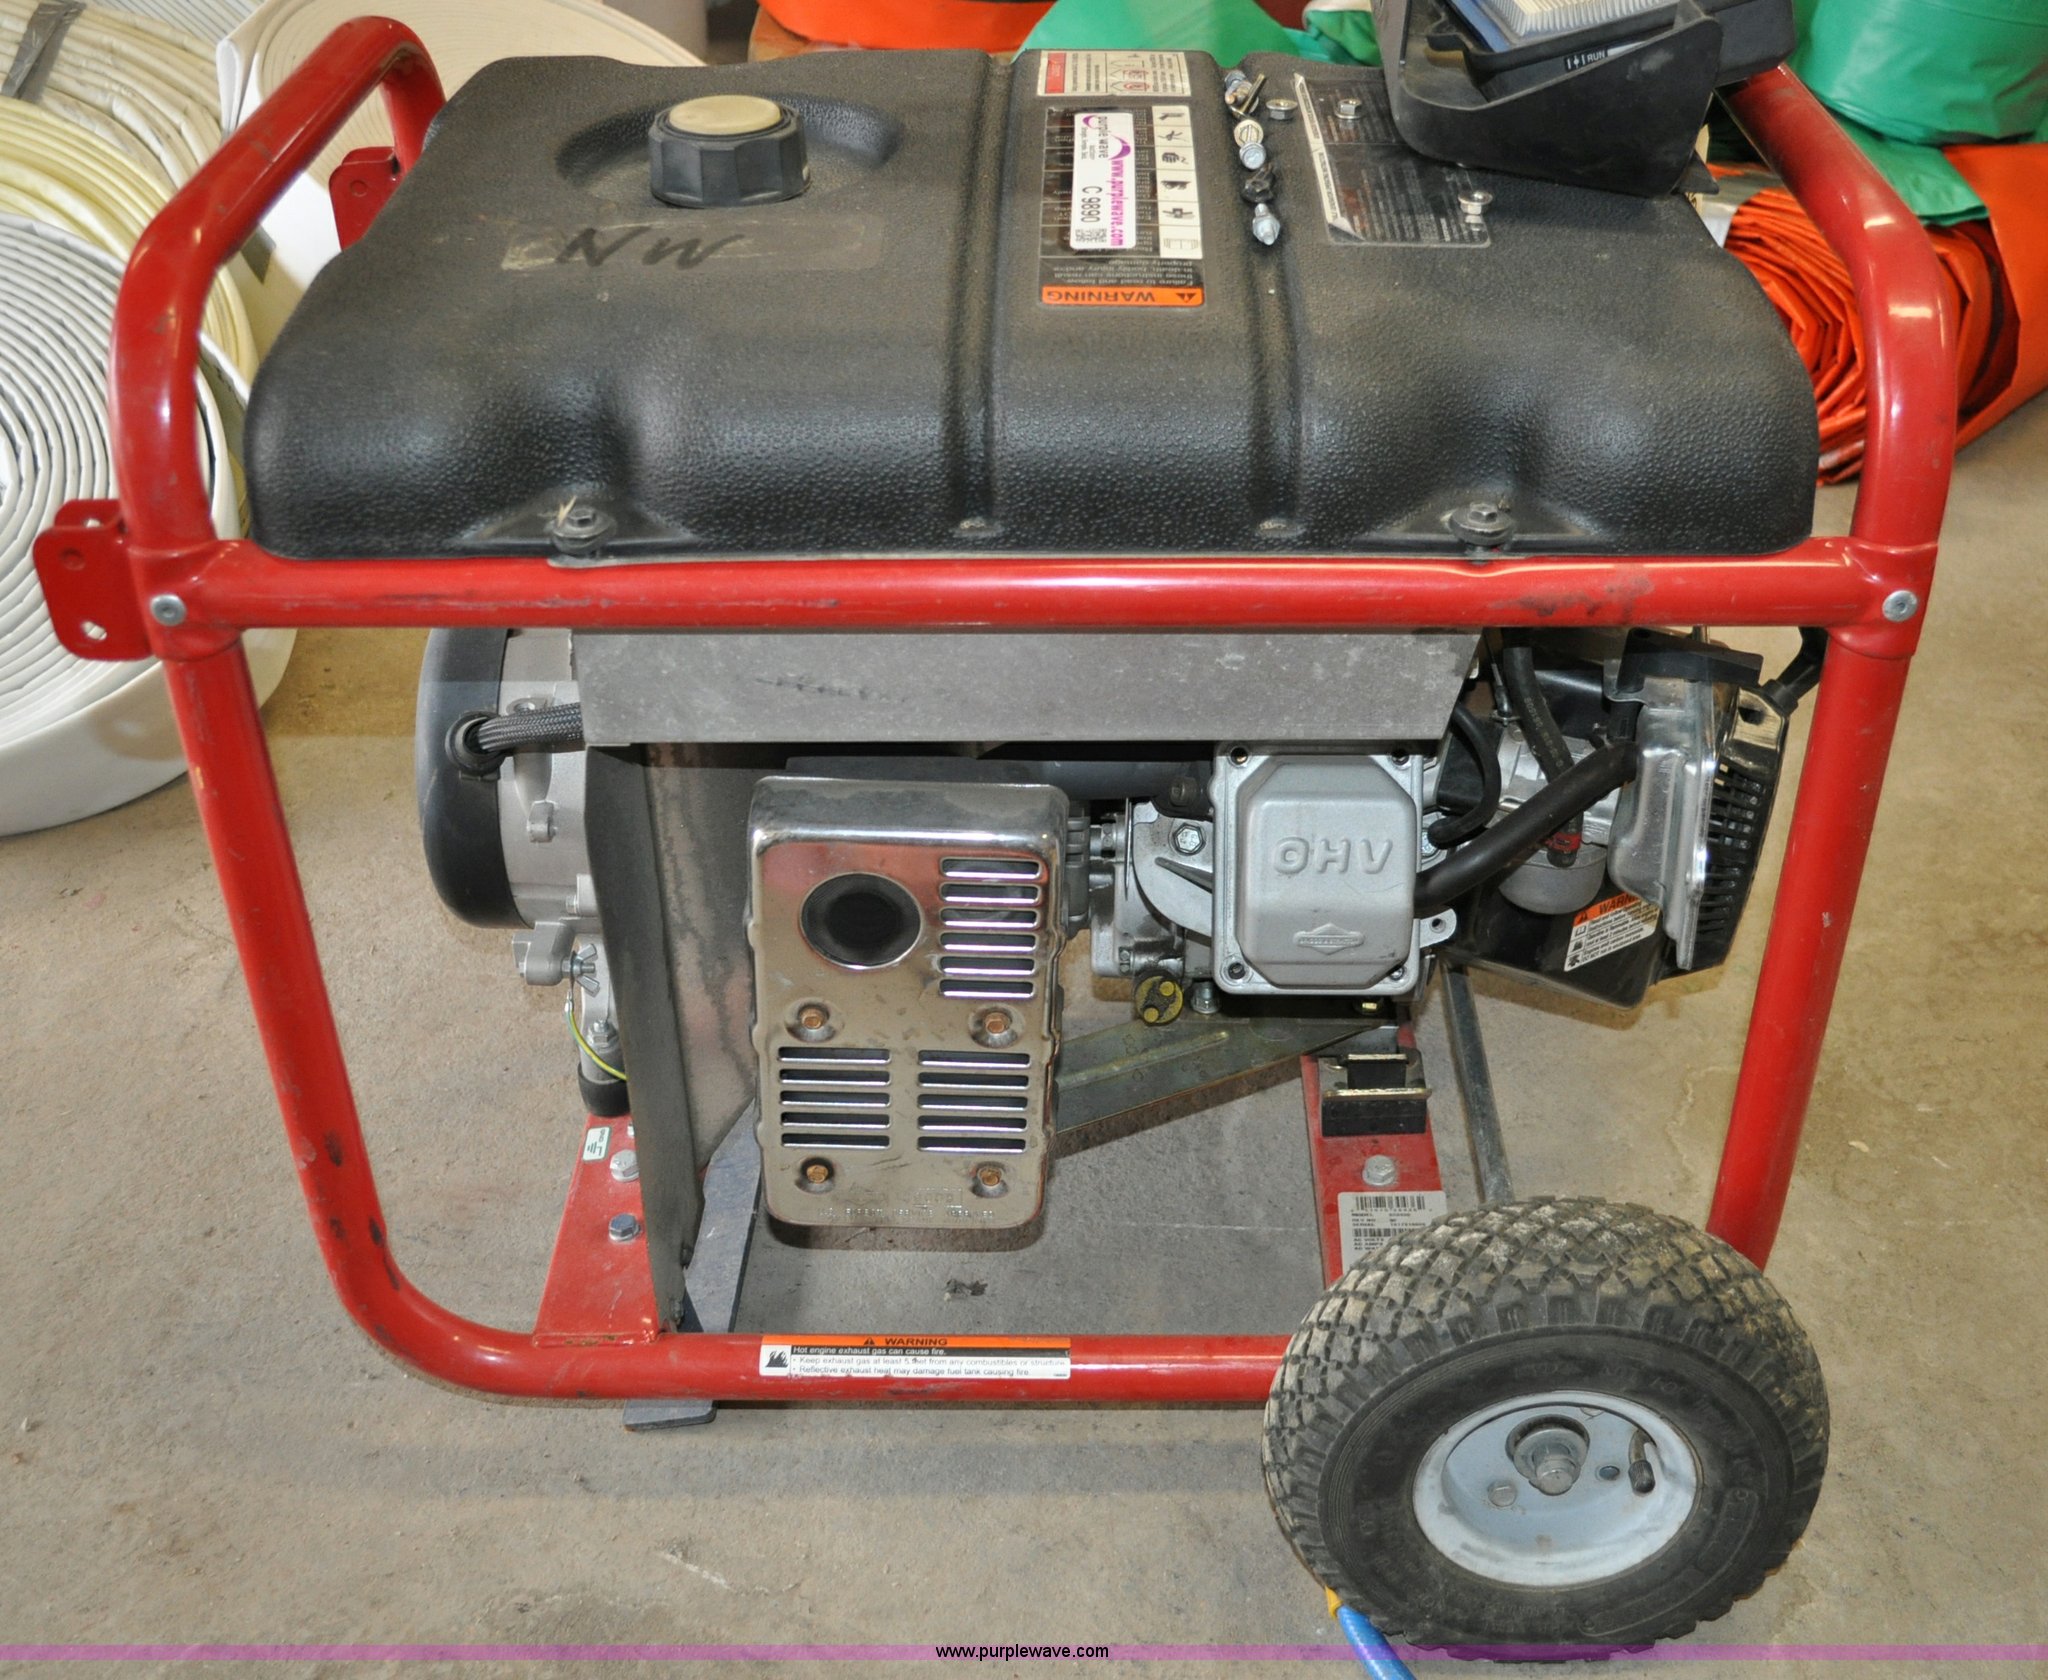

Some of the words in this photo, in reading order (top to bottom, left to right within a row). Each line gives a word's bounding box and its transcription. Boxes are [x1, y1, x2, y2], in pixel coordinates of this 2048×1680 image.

[1587, 50, 1605, 63] RUN
[1098, 139, 1109, 158] wave
[1082, 186, 1102, 194] C
[1106, 160, 1128, 246] www.purplewave.com
[1081, 198, 1101, 223] 9890
[1047, 291, 1155, 302] WARNING
[1274, 836, 1393, 874] OHV
[884, 1337, 948, 1346] WARNING
[793, 1346, 809, 1354] Hot
[810, 1347, 836, 1355] engine
[838, 1347, 870, 1355] exhaust
[872, 1348, 887, 1356] gas
[905, 1348, 930, 1356] cause
[800, 1357, 821, 1366] Keep
[823, 1357, 854, 1365] exhaust
[856, 1358, 870, 1367] gas
[929, 1359, 947, 1367] from
[949, 1360, 963, 1369] any
[966, 1359, 1018, 1368] combustibles
[800, 1366, 838, 1374] Reflective
[840, 1367, 871, 1375] exhaust
[873, 1367, 891, 1376] heat
[893, 1369, 910, 1377] may
[912, 1368, 945, 1378] damage
[947, 1368, 962, 1376] fuel
[983, 1369, 1014, 1379] causing
